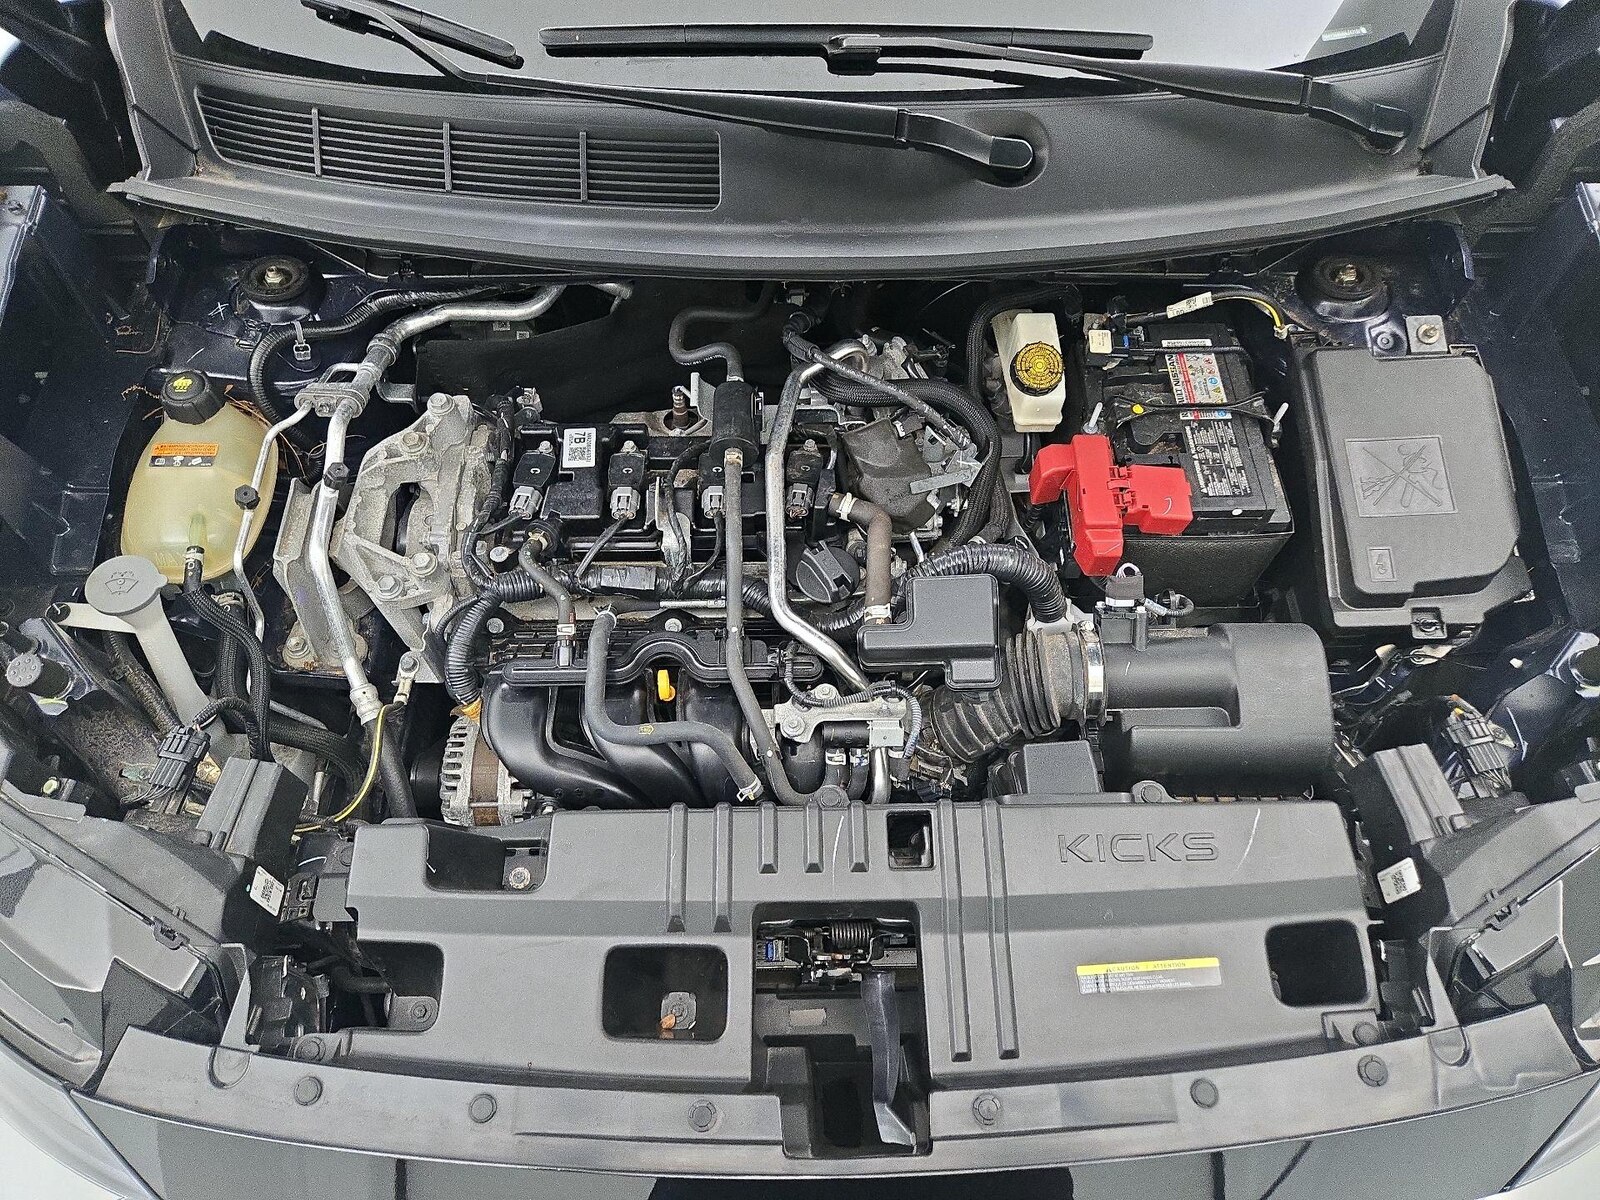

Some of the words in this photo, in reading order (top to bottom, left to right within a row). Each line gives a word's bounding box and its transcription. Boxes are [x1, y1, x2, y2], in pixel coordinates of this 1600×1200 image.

[1166, 354, 1180, 387] NISSAN
[574, 431, 586, 444] 7B
[1057, 832, 1219, 863] KICKS
[1152, 962, 1186, 970] ATTENTION
